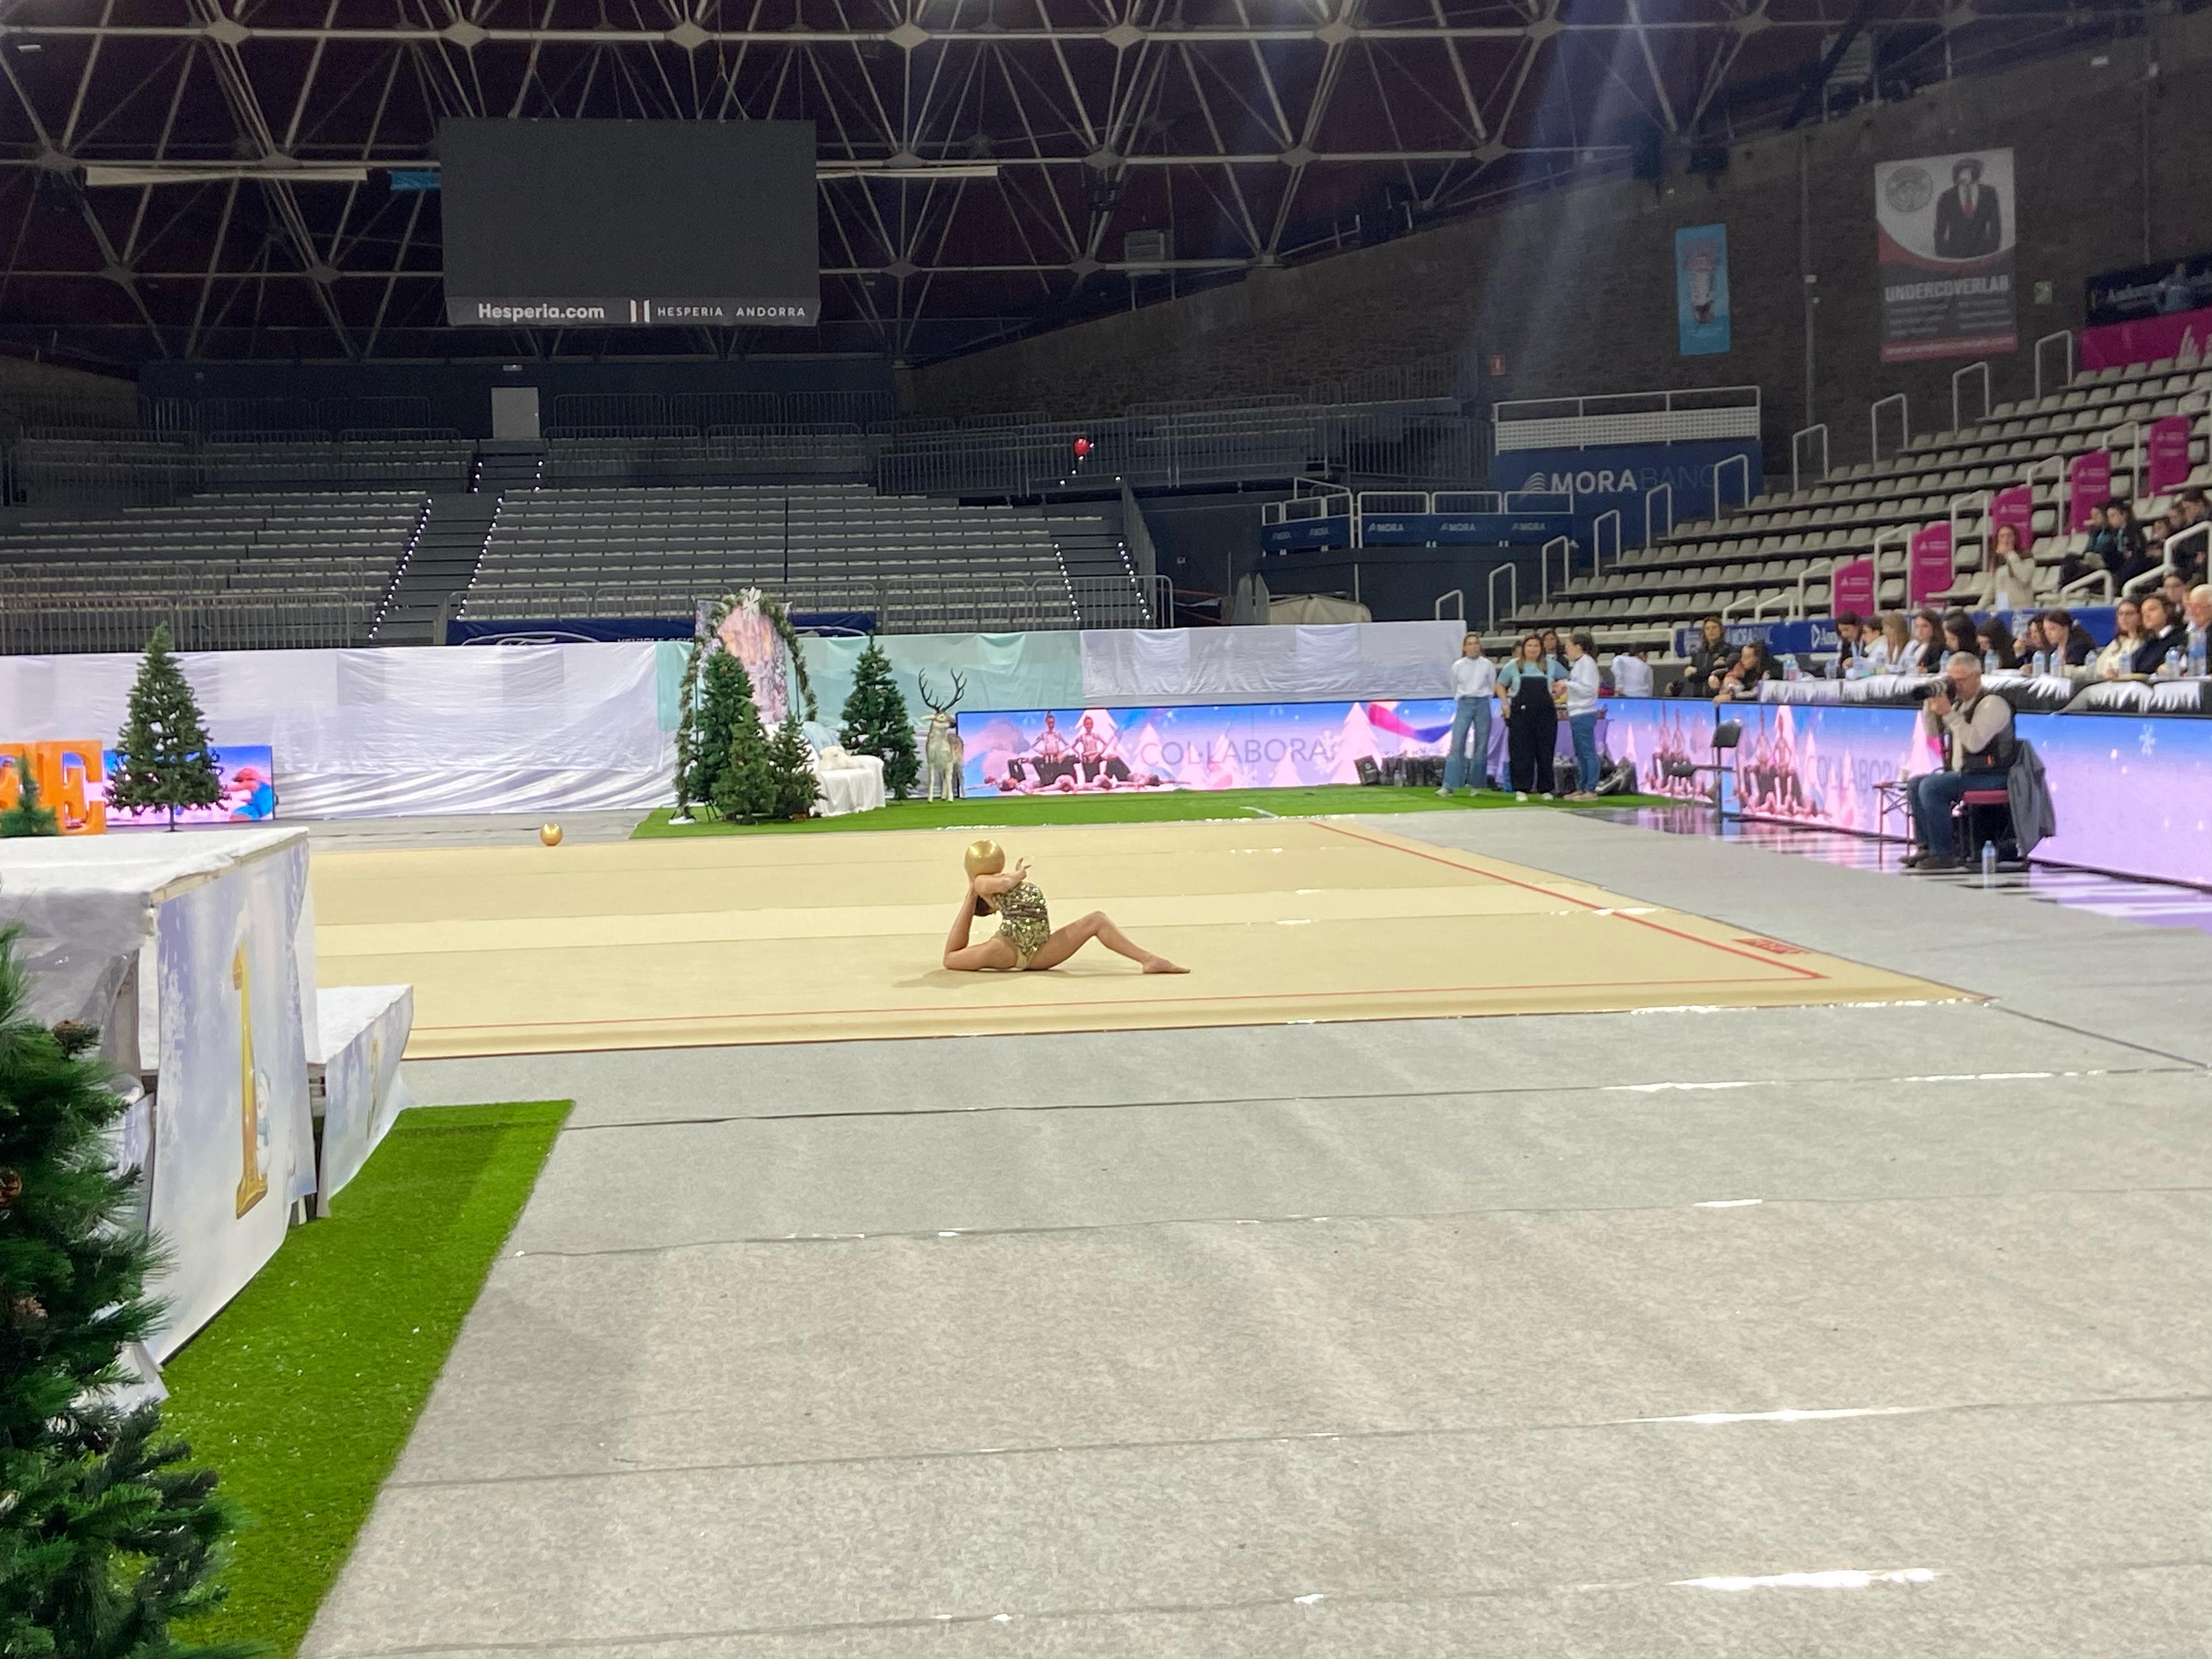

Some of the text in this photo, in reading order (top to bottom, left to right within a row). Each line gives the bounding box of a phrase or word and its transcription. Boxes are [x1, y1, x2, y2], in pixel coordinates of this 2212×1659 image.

[478, 302, 605, 323] Hesperia.com
[658, 307, 806, 317] HESPERIA ANDORRA
